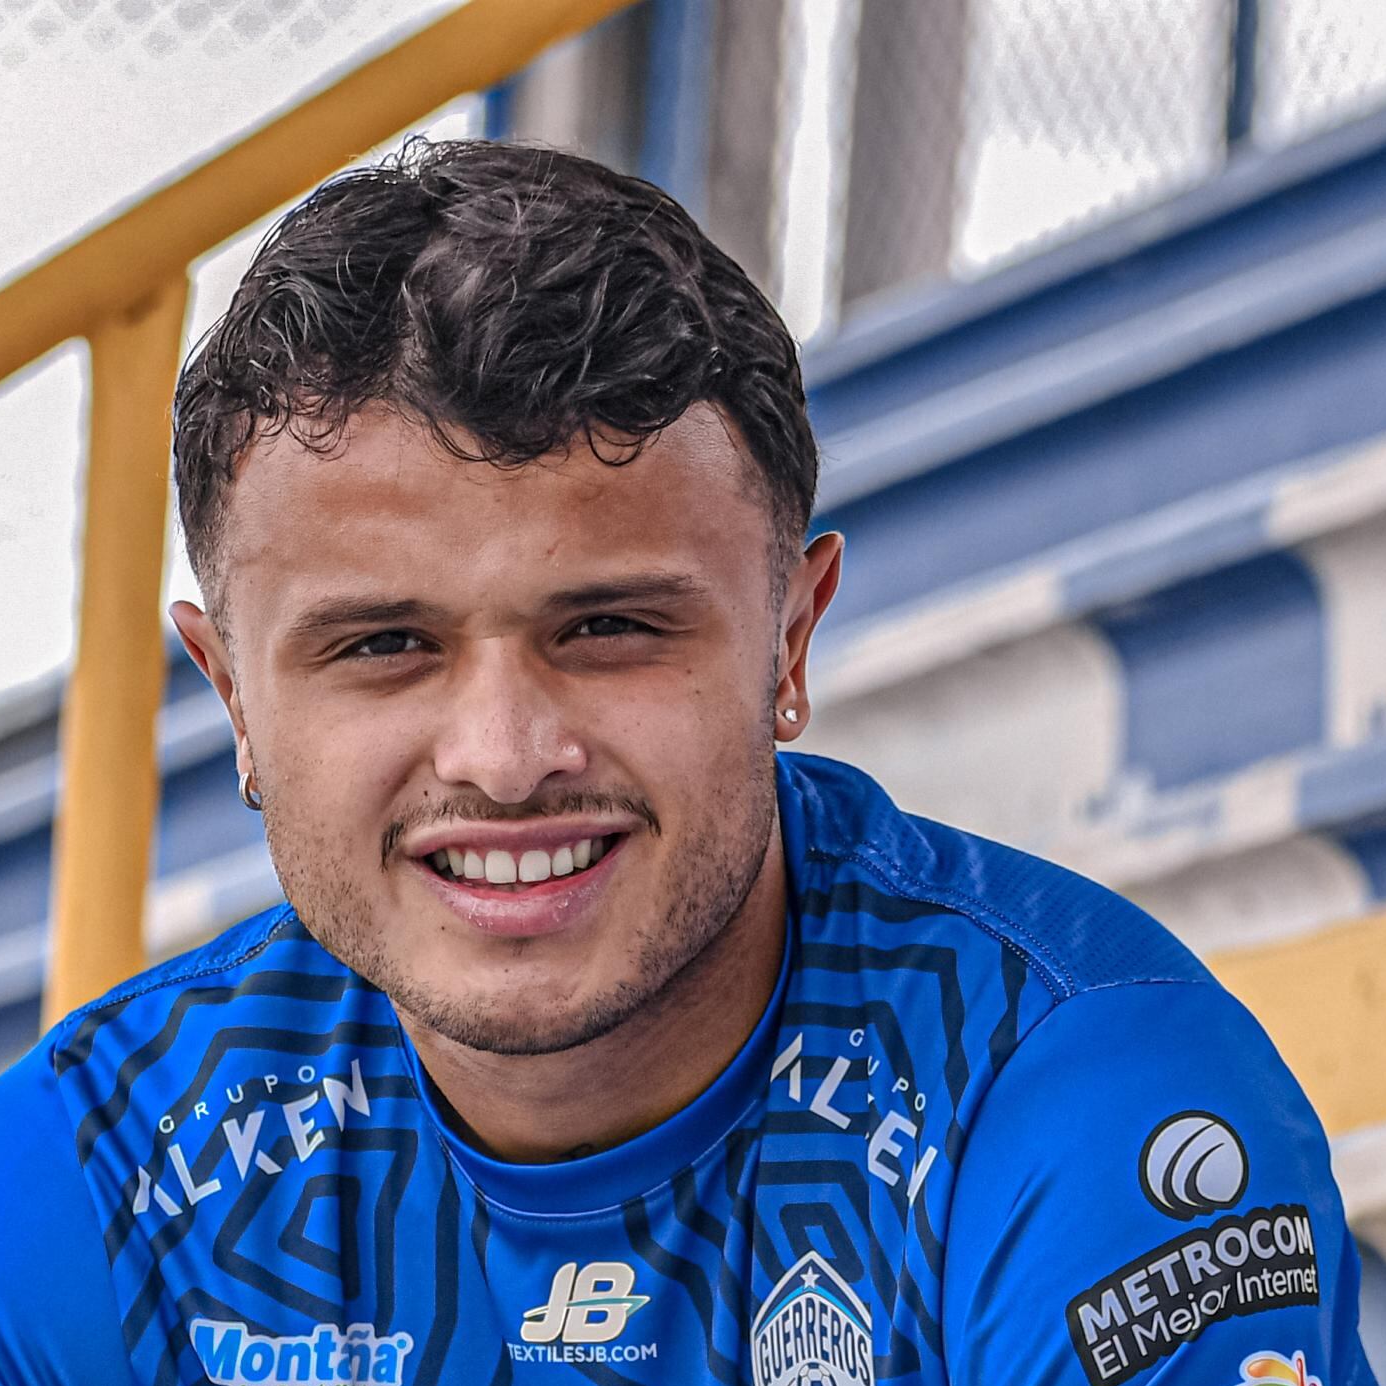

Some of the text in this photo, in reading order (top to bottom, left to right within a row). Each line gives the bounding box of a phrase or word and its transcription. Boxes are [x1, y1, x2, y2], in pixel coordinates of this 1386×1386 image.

[133, 1058, 370, 1216] ALKEN
[159, 1065, 316, 1133] GRUPO
[520, 1262, 635, 1342] JB
[1078, 1216, 1315, 1346] METROCOM
[1092, 1264, 1318, 1380] El Mejor Internet
[507, 1343, 658, 1362] TEXTILESJB.COM
